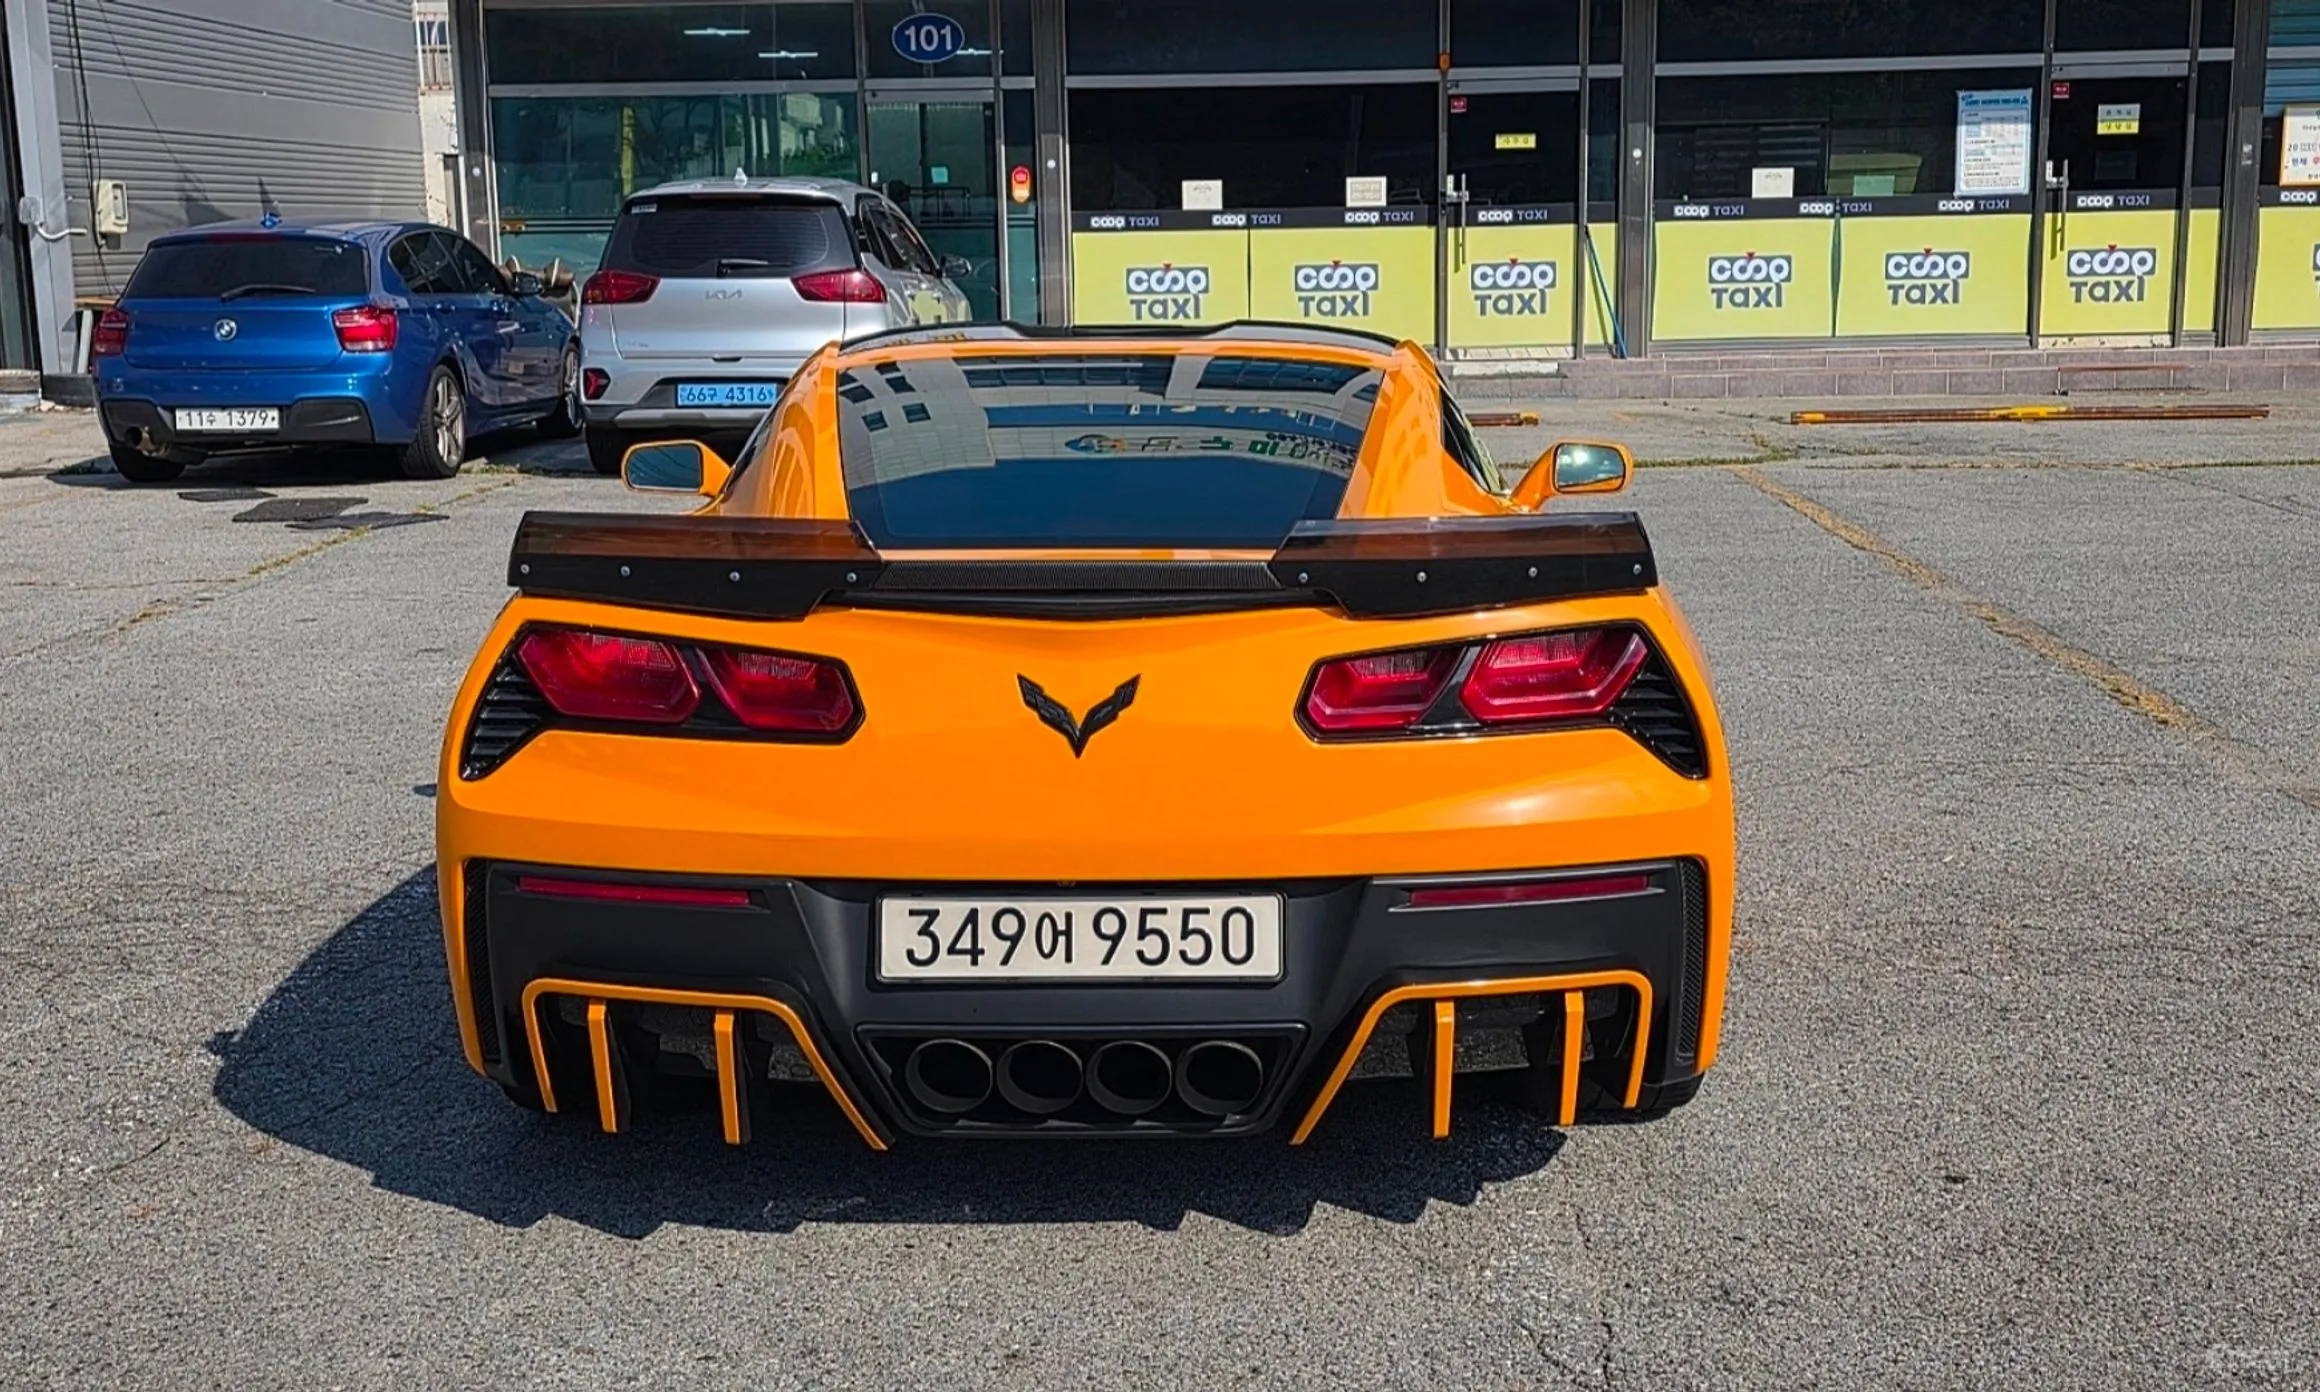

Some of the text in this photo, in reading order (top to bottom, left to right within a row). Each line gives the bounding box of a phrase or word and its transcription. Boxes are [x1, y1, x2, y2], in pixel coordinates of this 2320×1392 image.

[905, 25, 952, 52] 101
[705, 289, 743, 300] KIA
[686, 386, 768, 402] 66구 4316
[185, 409, 269, 427] 11수 1379
[905, 906, 1255, 967] 349어 9550
